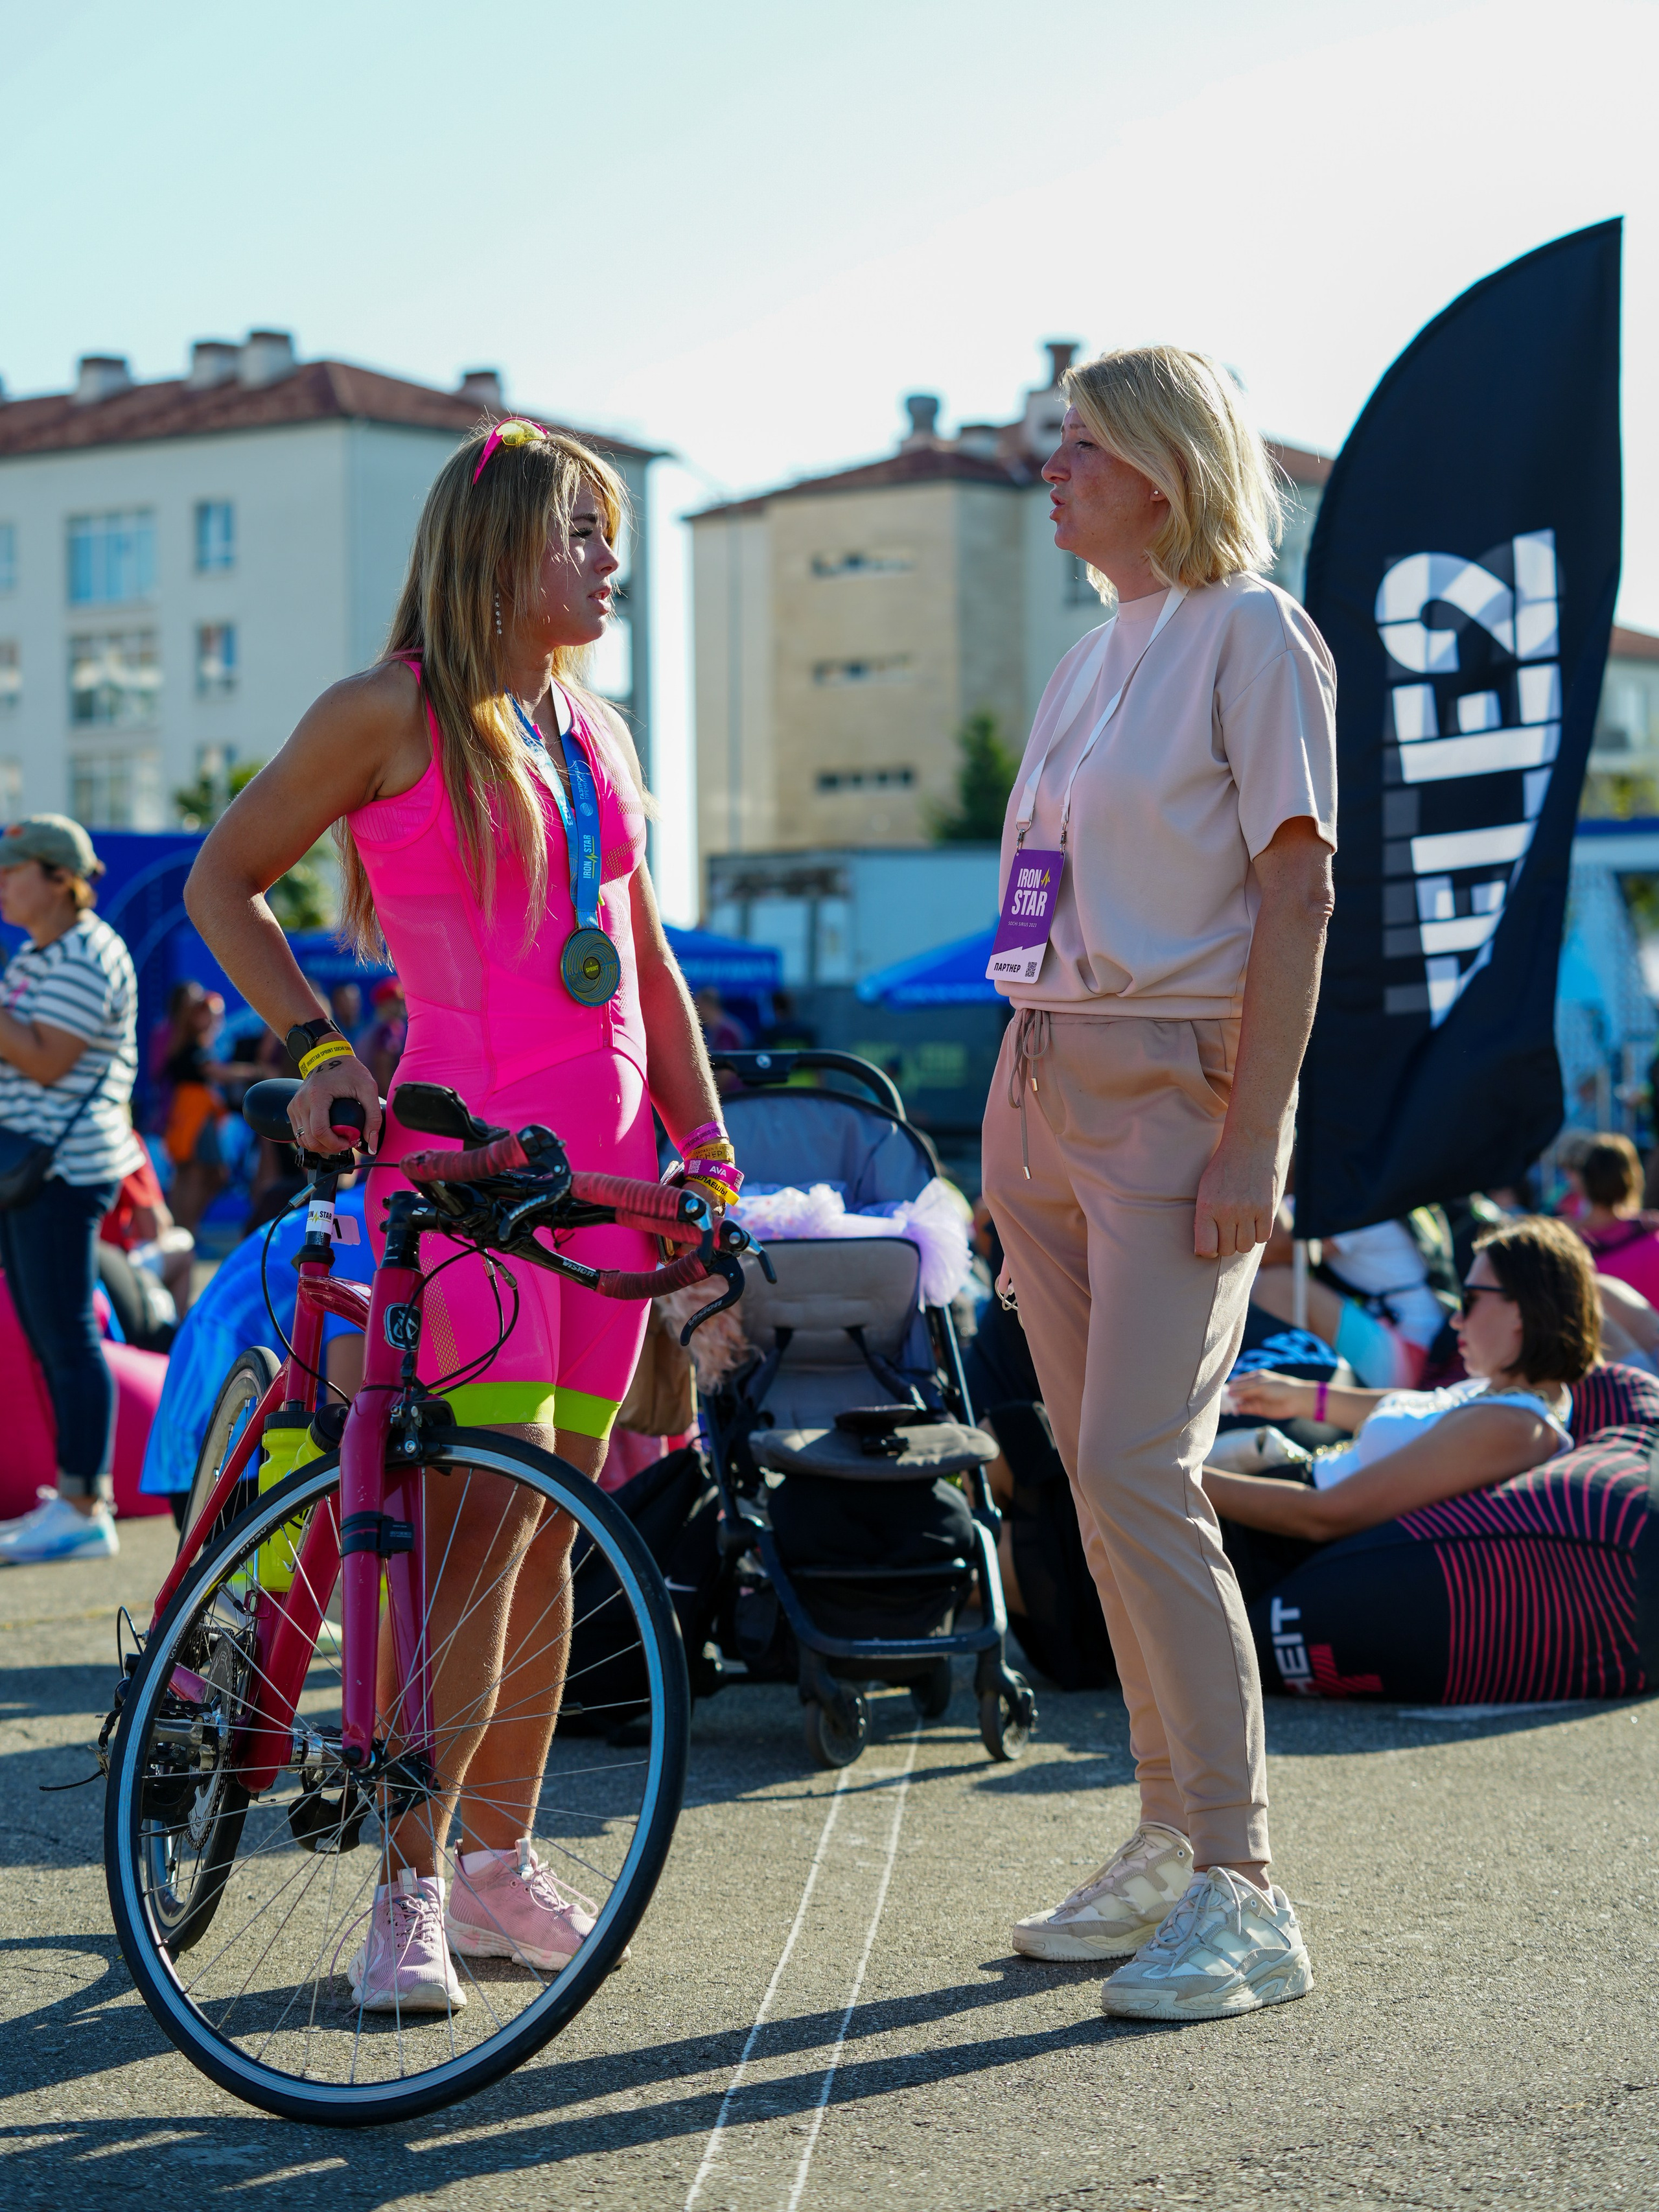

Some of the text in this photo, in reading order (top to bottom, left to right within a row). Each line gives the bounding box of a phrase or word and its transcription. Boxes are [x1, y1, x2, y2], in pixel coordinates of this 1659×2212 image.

[583, 834, 592, 879] IRON STAR
[1017, 868, 1043, 889] IRON
[1011, 889, 1048, 916] STAR
[585, 965, 599, 973] SPRINT
[993, 962, 1021, 973] ПАРТНЕР
[320, 1047, 334, 1057] SPRINT
[710, 1165, 726, 1178] AVA
[319, 1210, 332, 1221] STAR
